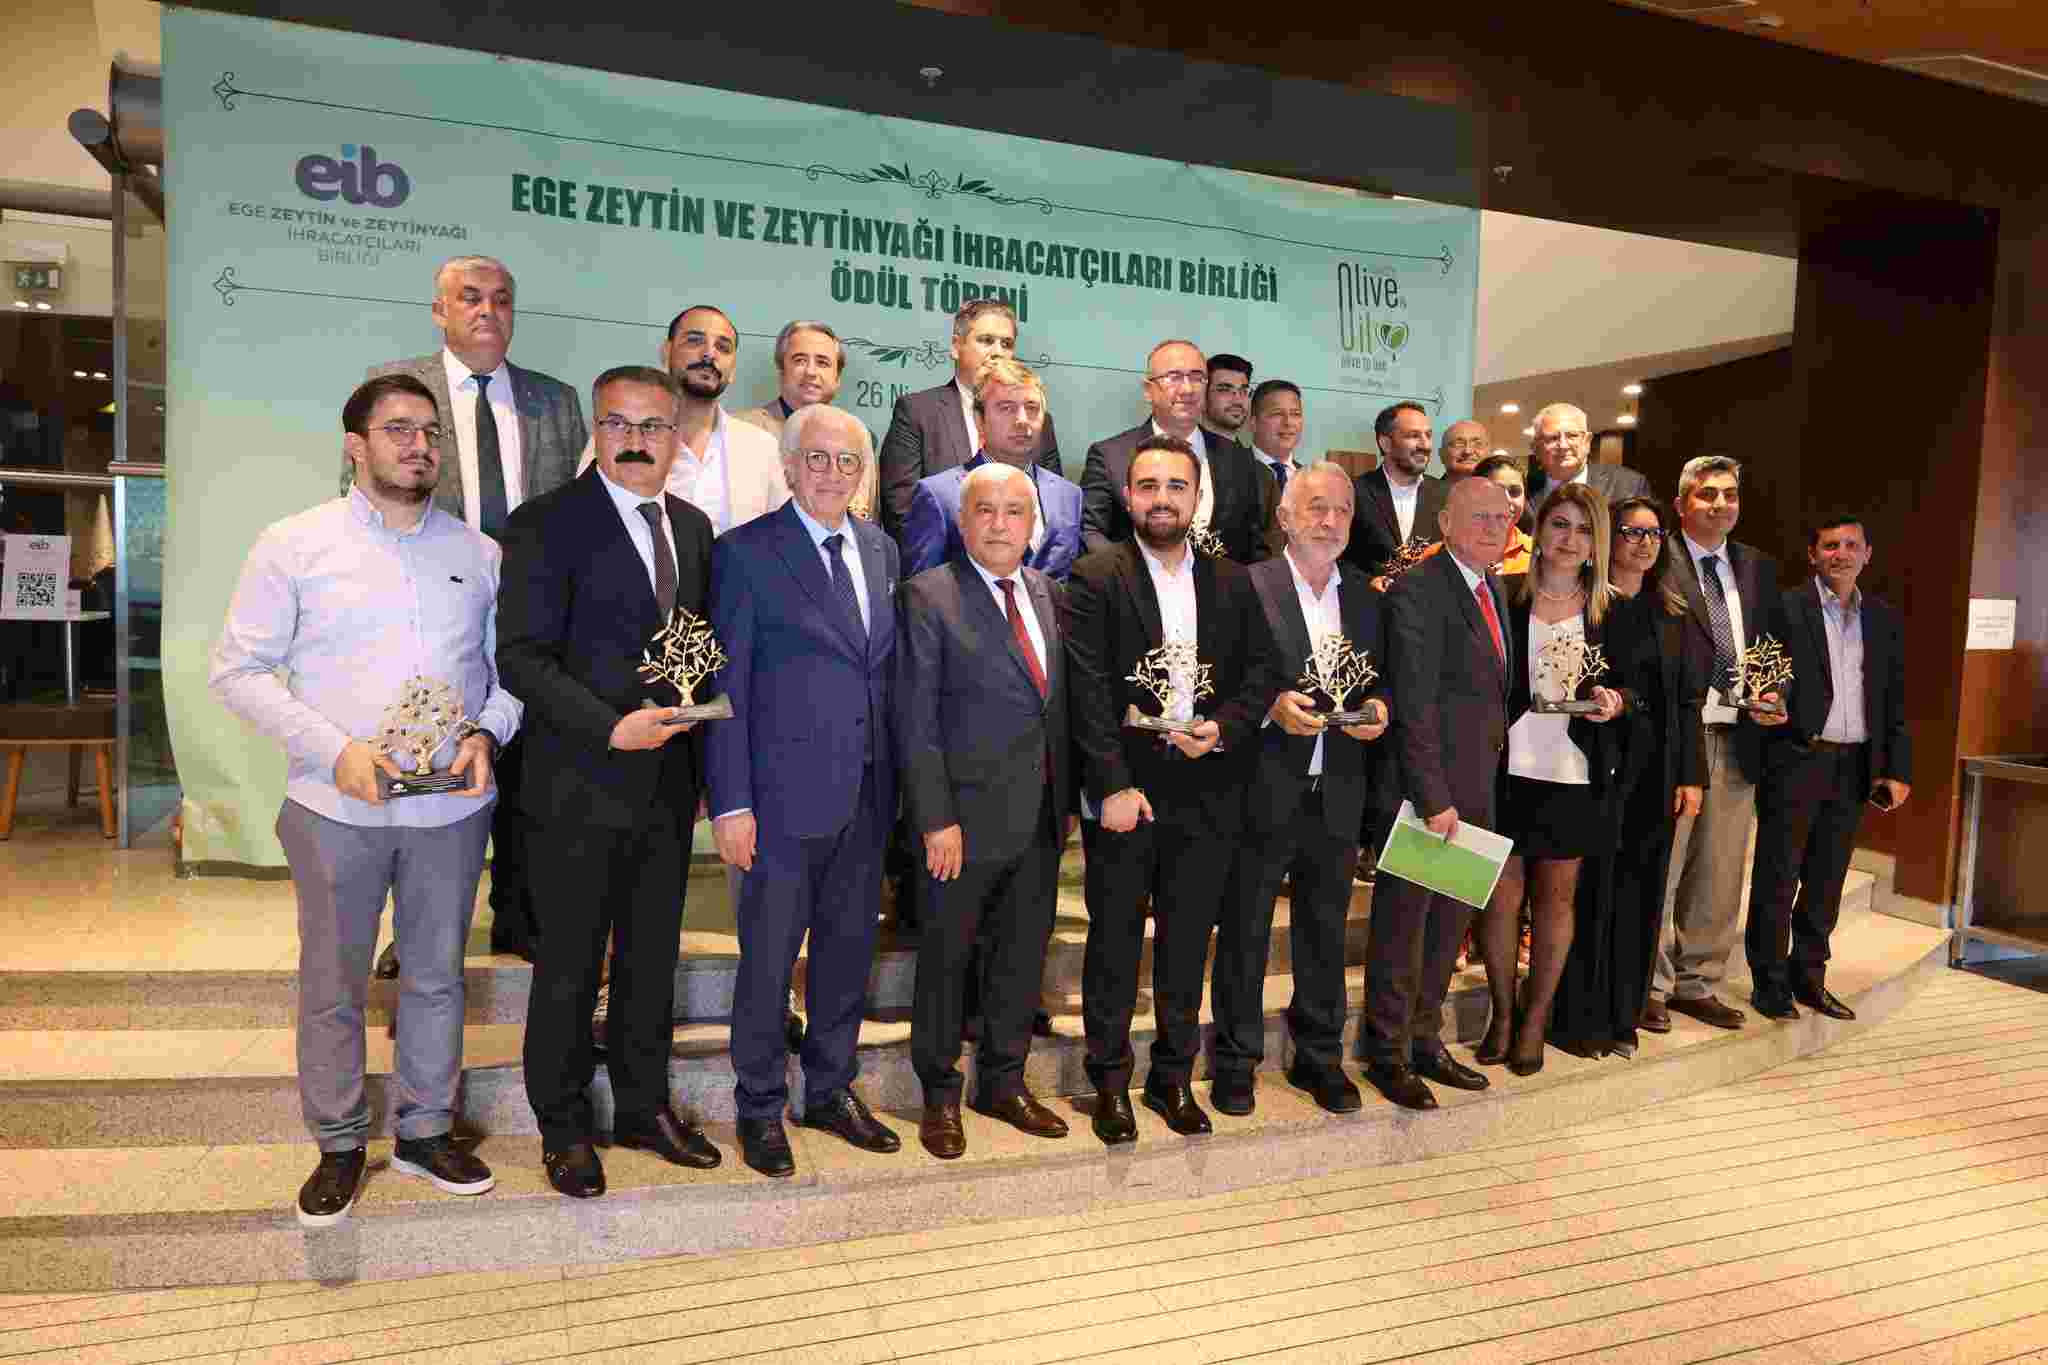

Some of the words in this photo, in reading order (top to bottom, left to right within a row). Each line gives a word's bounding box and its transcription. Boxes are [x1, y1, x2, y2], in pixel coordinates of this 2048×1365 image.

[296, 143, 410, 209] eib
[228, 201, 265, 218] EGE
[270, 206, 336, 225] ZEYTİN
[340, 216, 361, 228] ve
[512, 172, 576, 220] EGE
[585, 184, 705, 235] ZEYTİN
[713, 199, 755, 241] VE
[763, 206, 945, 262] ZEYTİNYAĞI
[952, 224, 1172, 291] İHRACATÇILARI
[1179, 256, 1279, 303] BİRLİĞİ
[830, 259, 913, 310] ÖDÜL
[857, 380, 882, 408] 26
